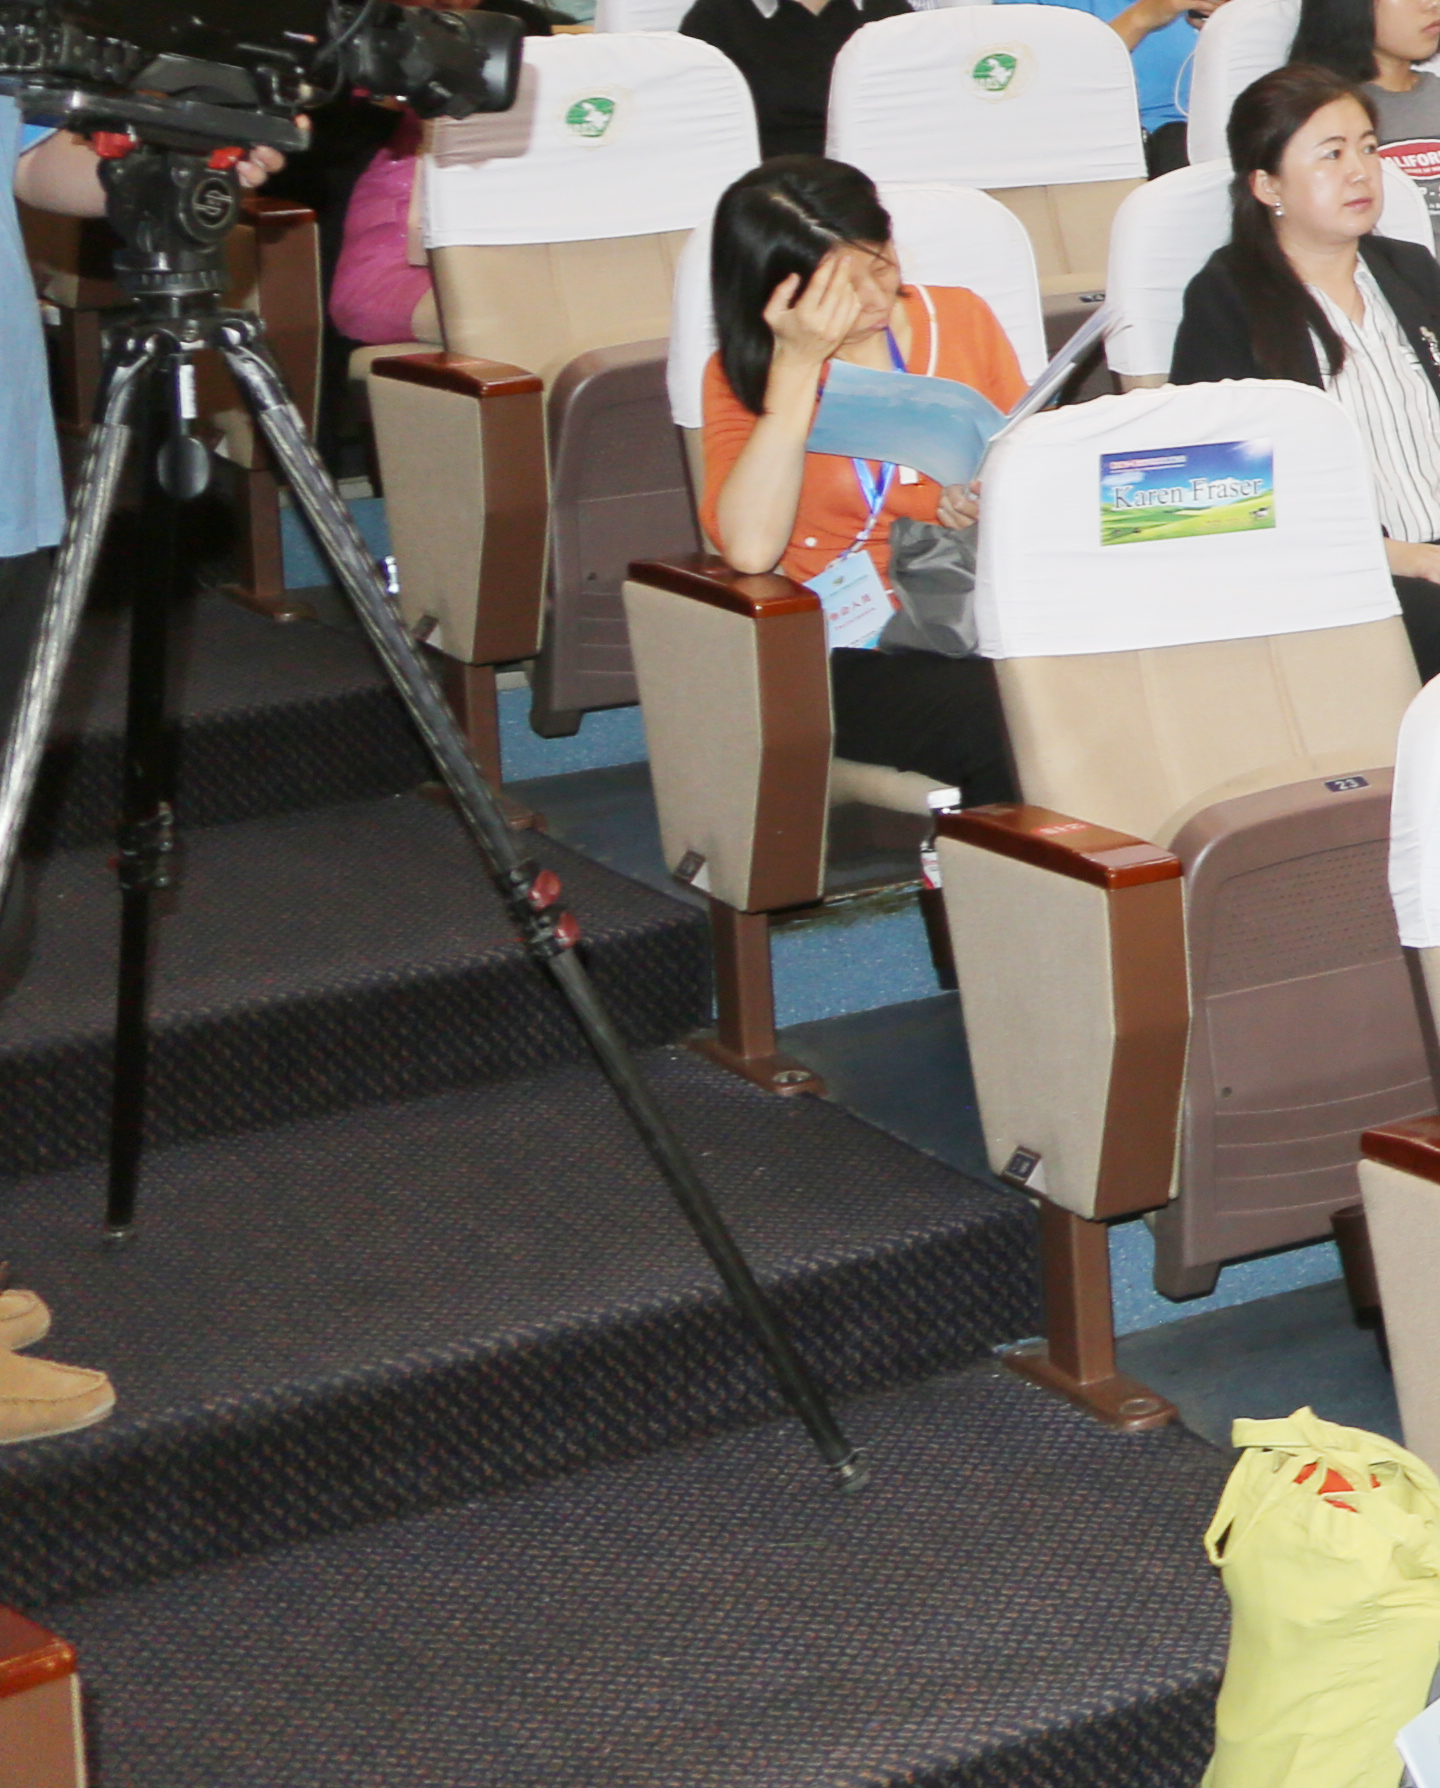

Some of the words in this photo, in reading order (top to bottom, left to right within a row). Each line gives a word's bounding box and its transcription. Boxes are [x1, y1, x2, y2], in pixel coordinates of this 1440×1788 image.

[1113, 486, 1183, 510] Karen
[1191, 478, 1262, 502] Fraser
[1335, 778, 1359, 790] 23
